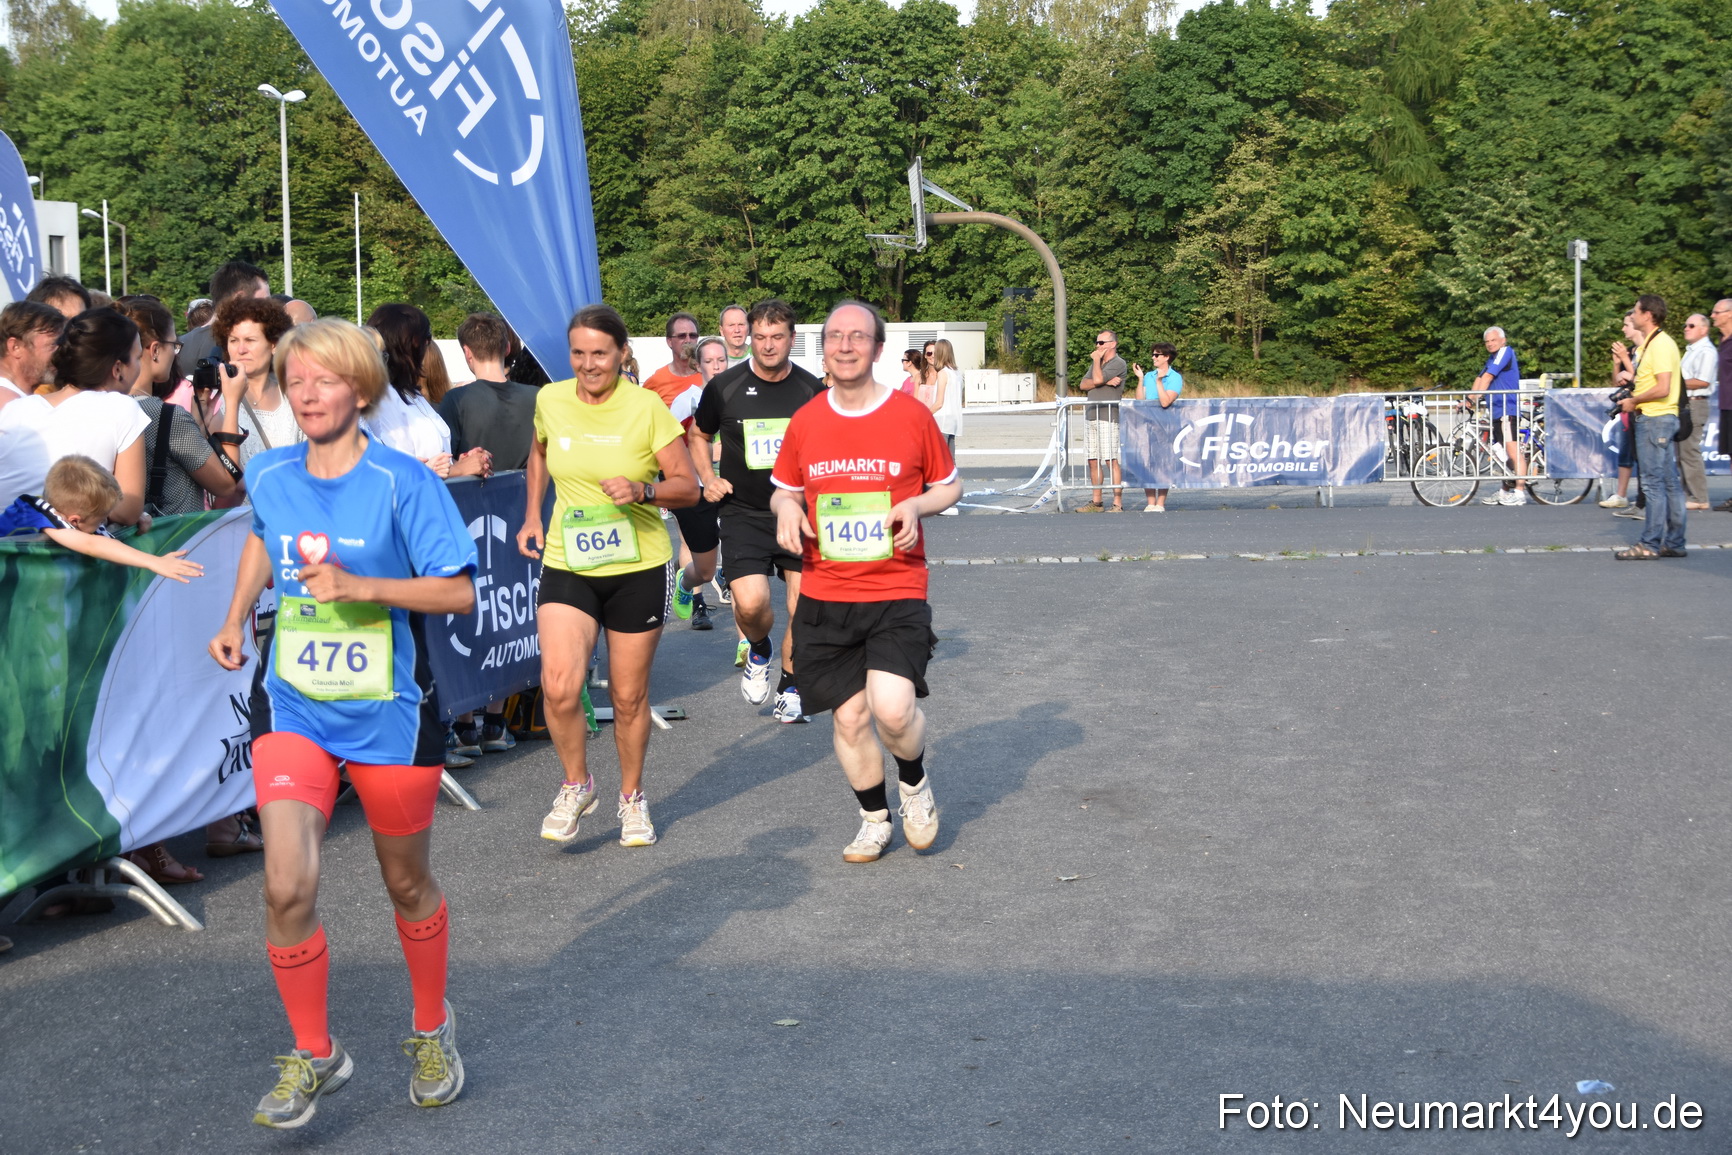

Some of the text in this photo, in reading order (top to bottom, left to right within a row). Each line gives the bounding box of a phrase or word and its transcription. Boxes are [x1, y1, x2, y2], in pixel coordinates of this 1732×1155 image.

[1201, 435, 1329, 460] Fischer
[220, 454, 238, 473] SONY
[808, 458, 886, 477] NEUMARKT
[1213, 462, 1319, 474] AUTOMOBILE
[576, 528, 621, 552] 664
[825, 520, 884, 542] 1404
[280, 535, 294, 565] I
[297, 640, 368, 673] 476
